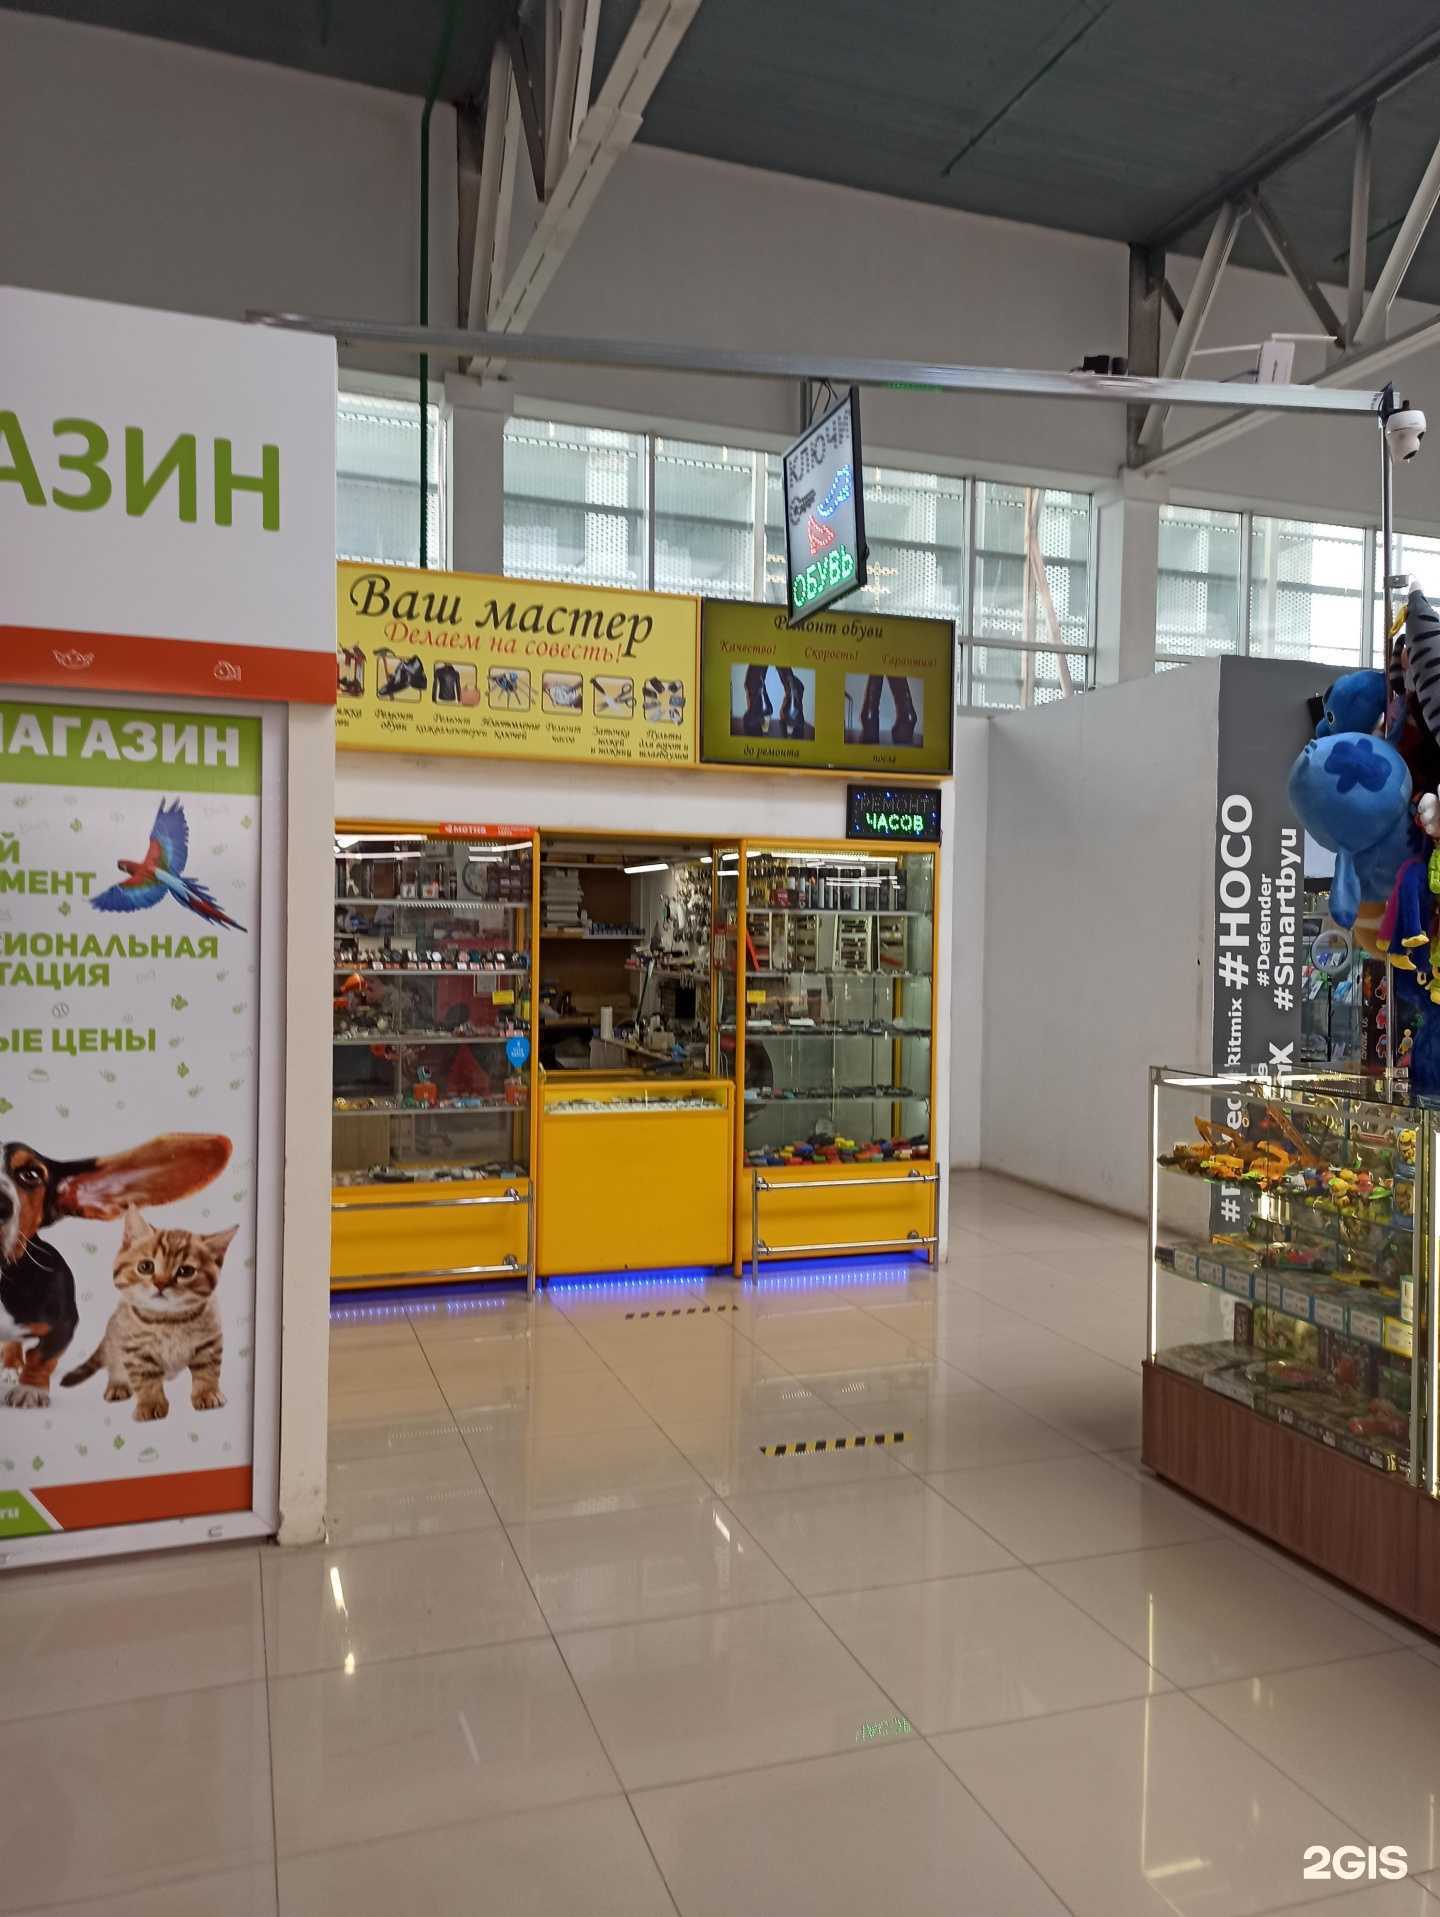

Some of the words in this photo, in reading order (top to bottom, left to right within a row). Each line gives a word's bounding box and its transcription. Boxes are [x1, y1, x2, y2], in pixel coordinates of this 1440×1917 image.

[0, 410, 280, 532] АЗИН
[792, 544, 855, 609] ОБУВЬ
[350, 574, 462, 626] Ваш
[475, 598, 654, 658] мастер
[384, 619, 480, 650] Делаем
[488, 635, 517, 656] на
[524, 639, 624, 664] совесть!
[842, 620, 883, 641] обуви
[0, 711, 240, 769] АГАЗИН
[866, 812, 925, 832] ЧАСОВ
[0, 870, 97, 896] МЕНТ
[1219, 794, 1252, 990] #HOCO
[0, 931, 219, 960] ИОНАЛЬНАЯ
[1256, 873, 1272, 988] #Defender
[1273, 828, 1302, 1012] #Smartbyu
[51, 1029, 157, 1057] ЦЕНЫ
